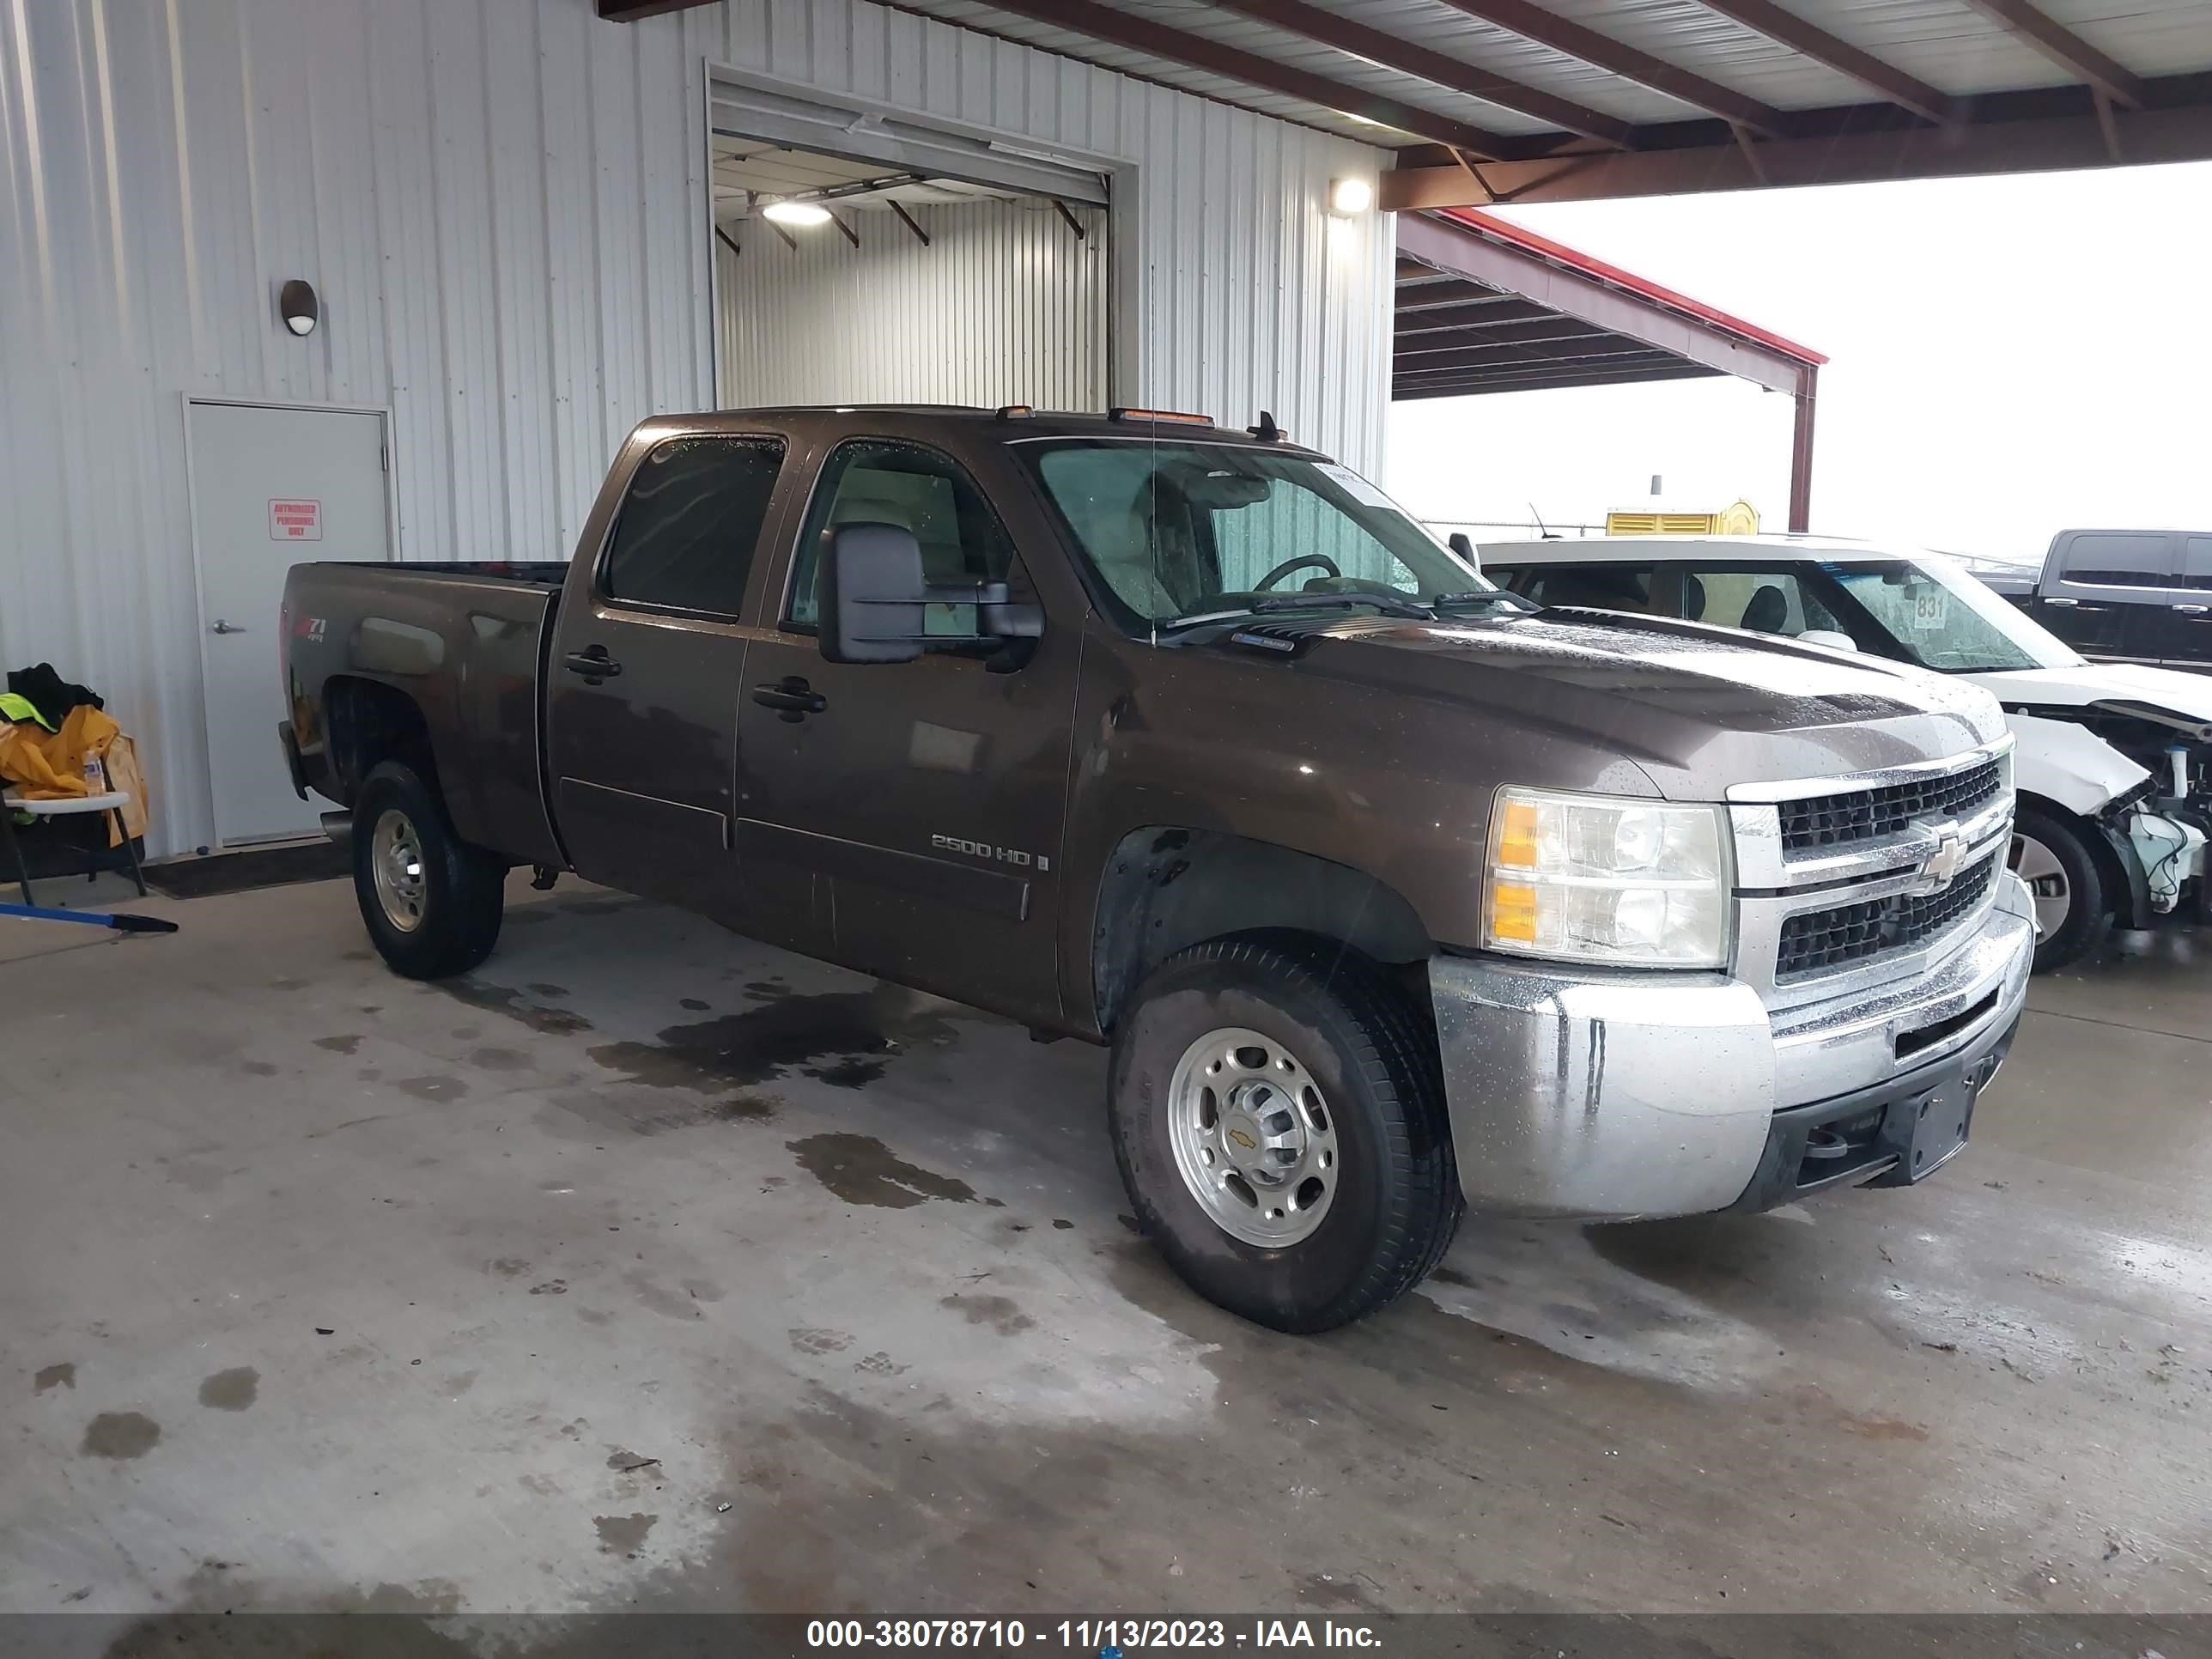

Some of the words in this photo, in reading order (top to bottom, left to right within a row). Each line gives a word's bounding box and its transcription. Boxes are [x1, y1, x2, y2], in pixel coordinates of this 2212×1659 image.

[1917, 596, 1944, 618] 831
[932, 834, 992, 859] 2500
[996, 846, 1030, 866] HD
